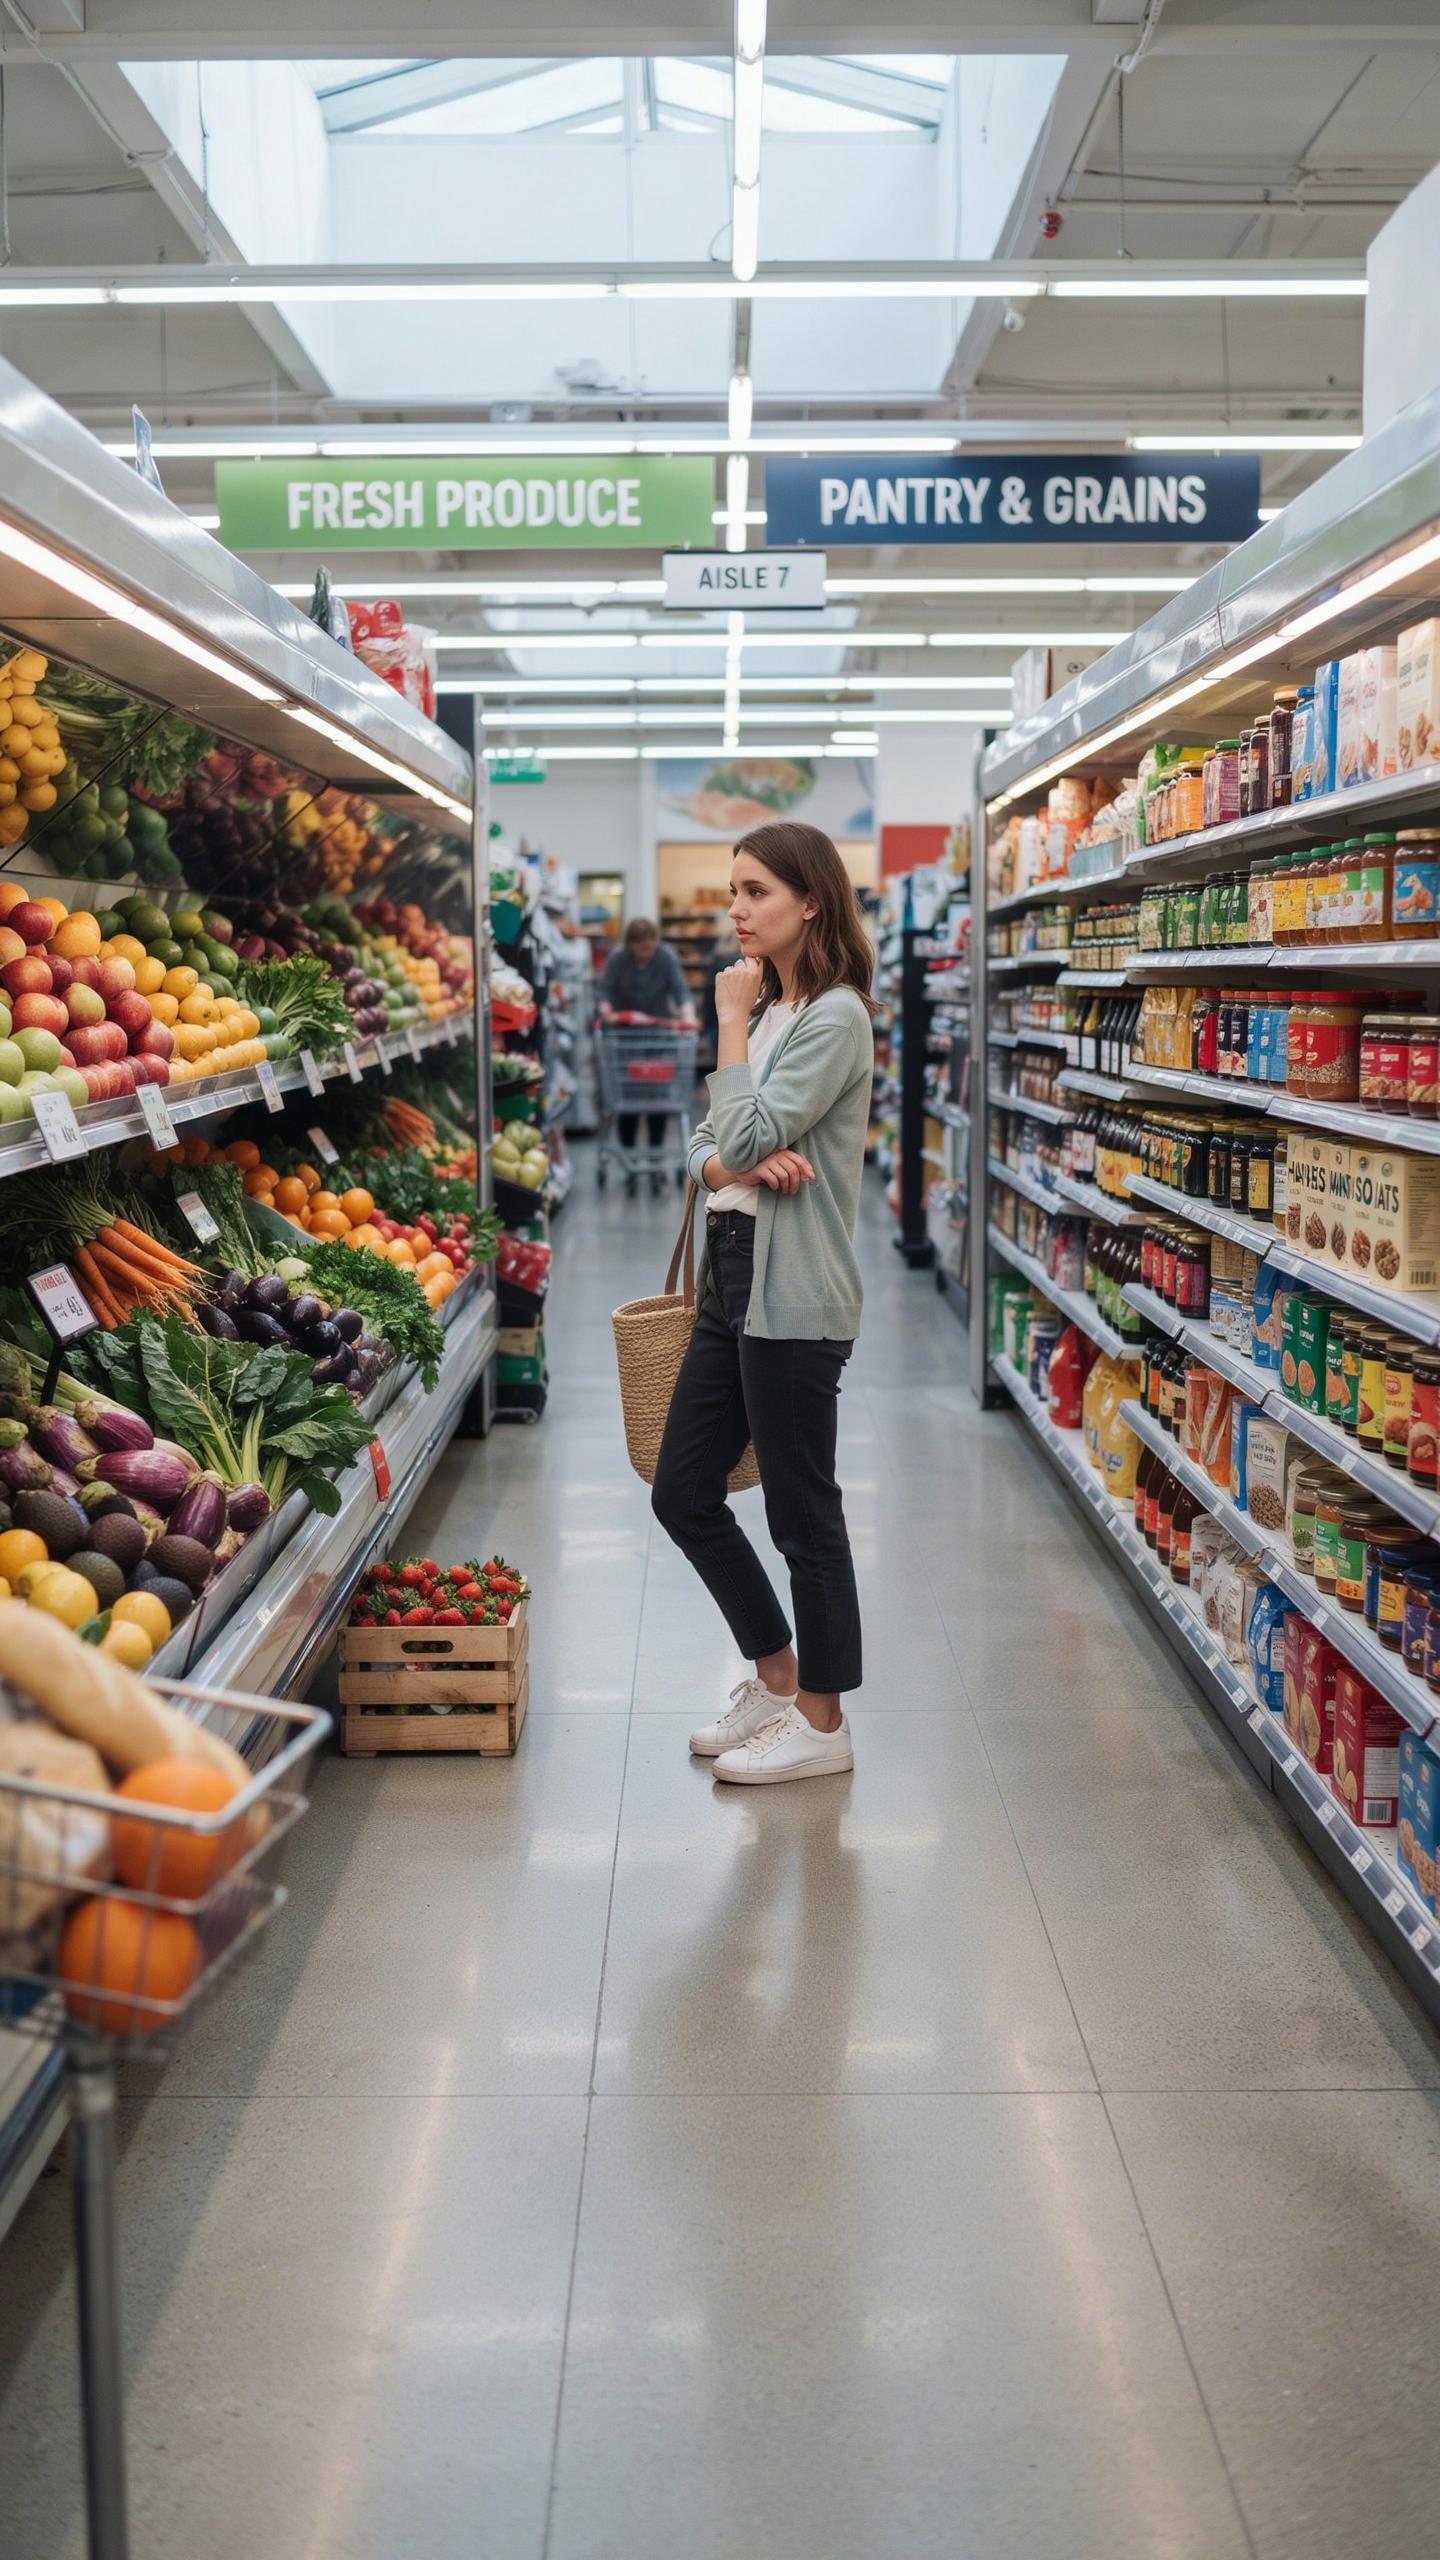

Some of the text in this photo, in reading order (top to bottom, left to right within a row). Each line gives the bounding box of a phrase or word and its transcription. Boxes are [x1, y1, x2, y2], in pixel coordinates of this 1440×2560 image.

[287, 478, 641, 530] FRESH PRODUCE
[820, 475, 1207, 526] PANTRY & GRAINS
[699, 566, 790, 590] AISLE 7
